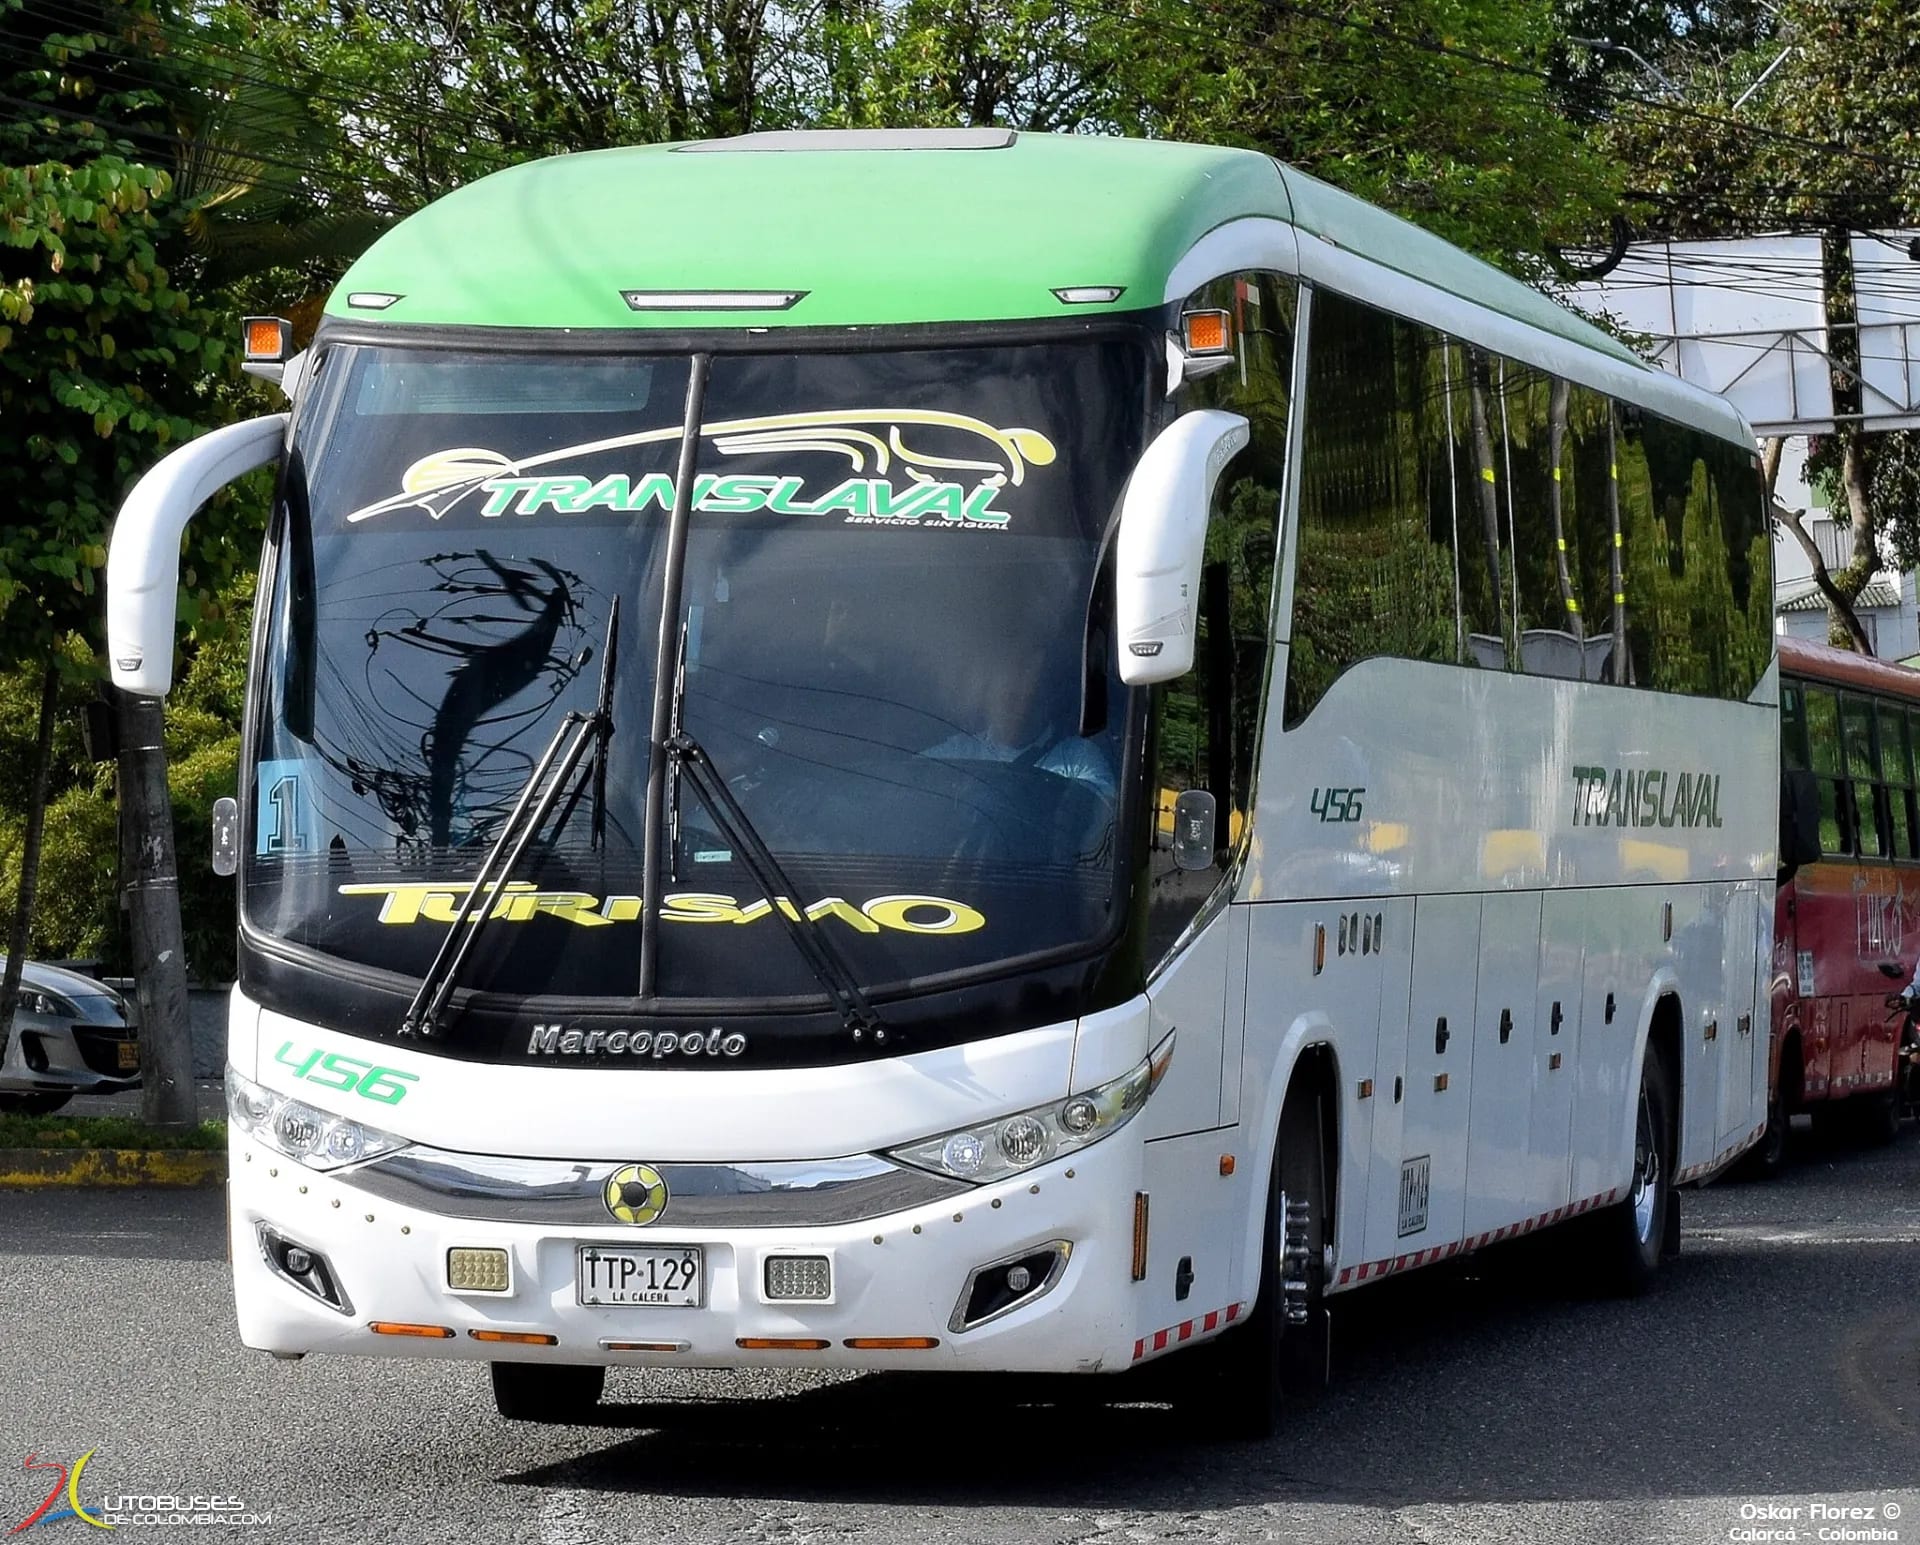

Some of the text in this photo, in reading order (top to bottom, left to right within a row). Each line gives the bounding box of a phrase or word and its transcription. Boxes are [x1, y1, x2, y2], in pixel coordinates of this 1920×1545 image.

[482, 473, 1012, 523] TRANSLAVAL
[844, 515, 1009, 531] SERVICIO SIN IGUAL
[1310, 787, 1366, 822] 456
[1572, 766, 1722, 828] TRANSLAVAL
[338, 881, 986, 934] TURISMO
[527, 1024, 748, 1058] Marcopolo
[274, 1040, 420, 1105] 456
[612, 1292, 670, 1303] LA CALERA
